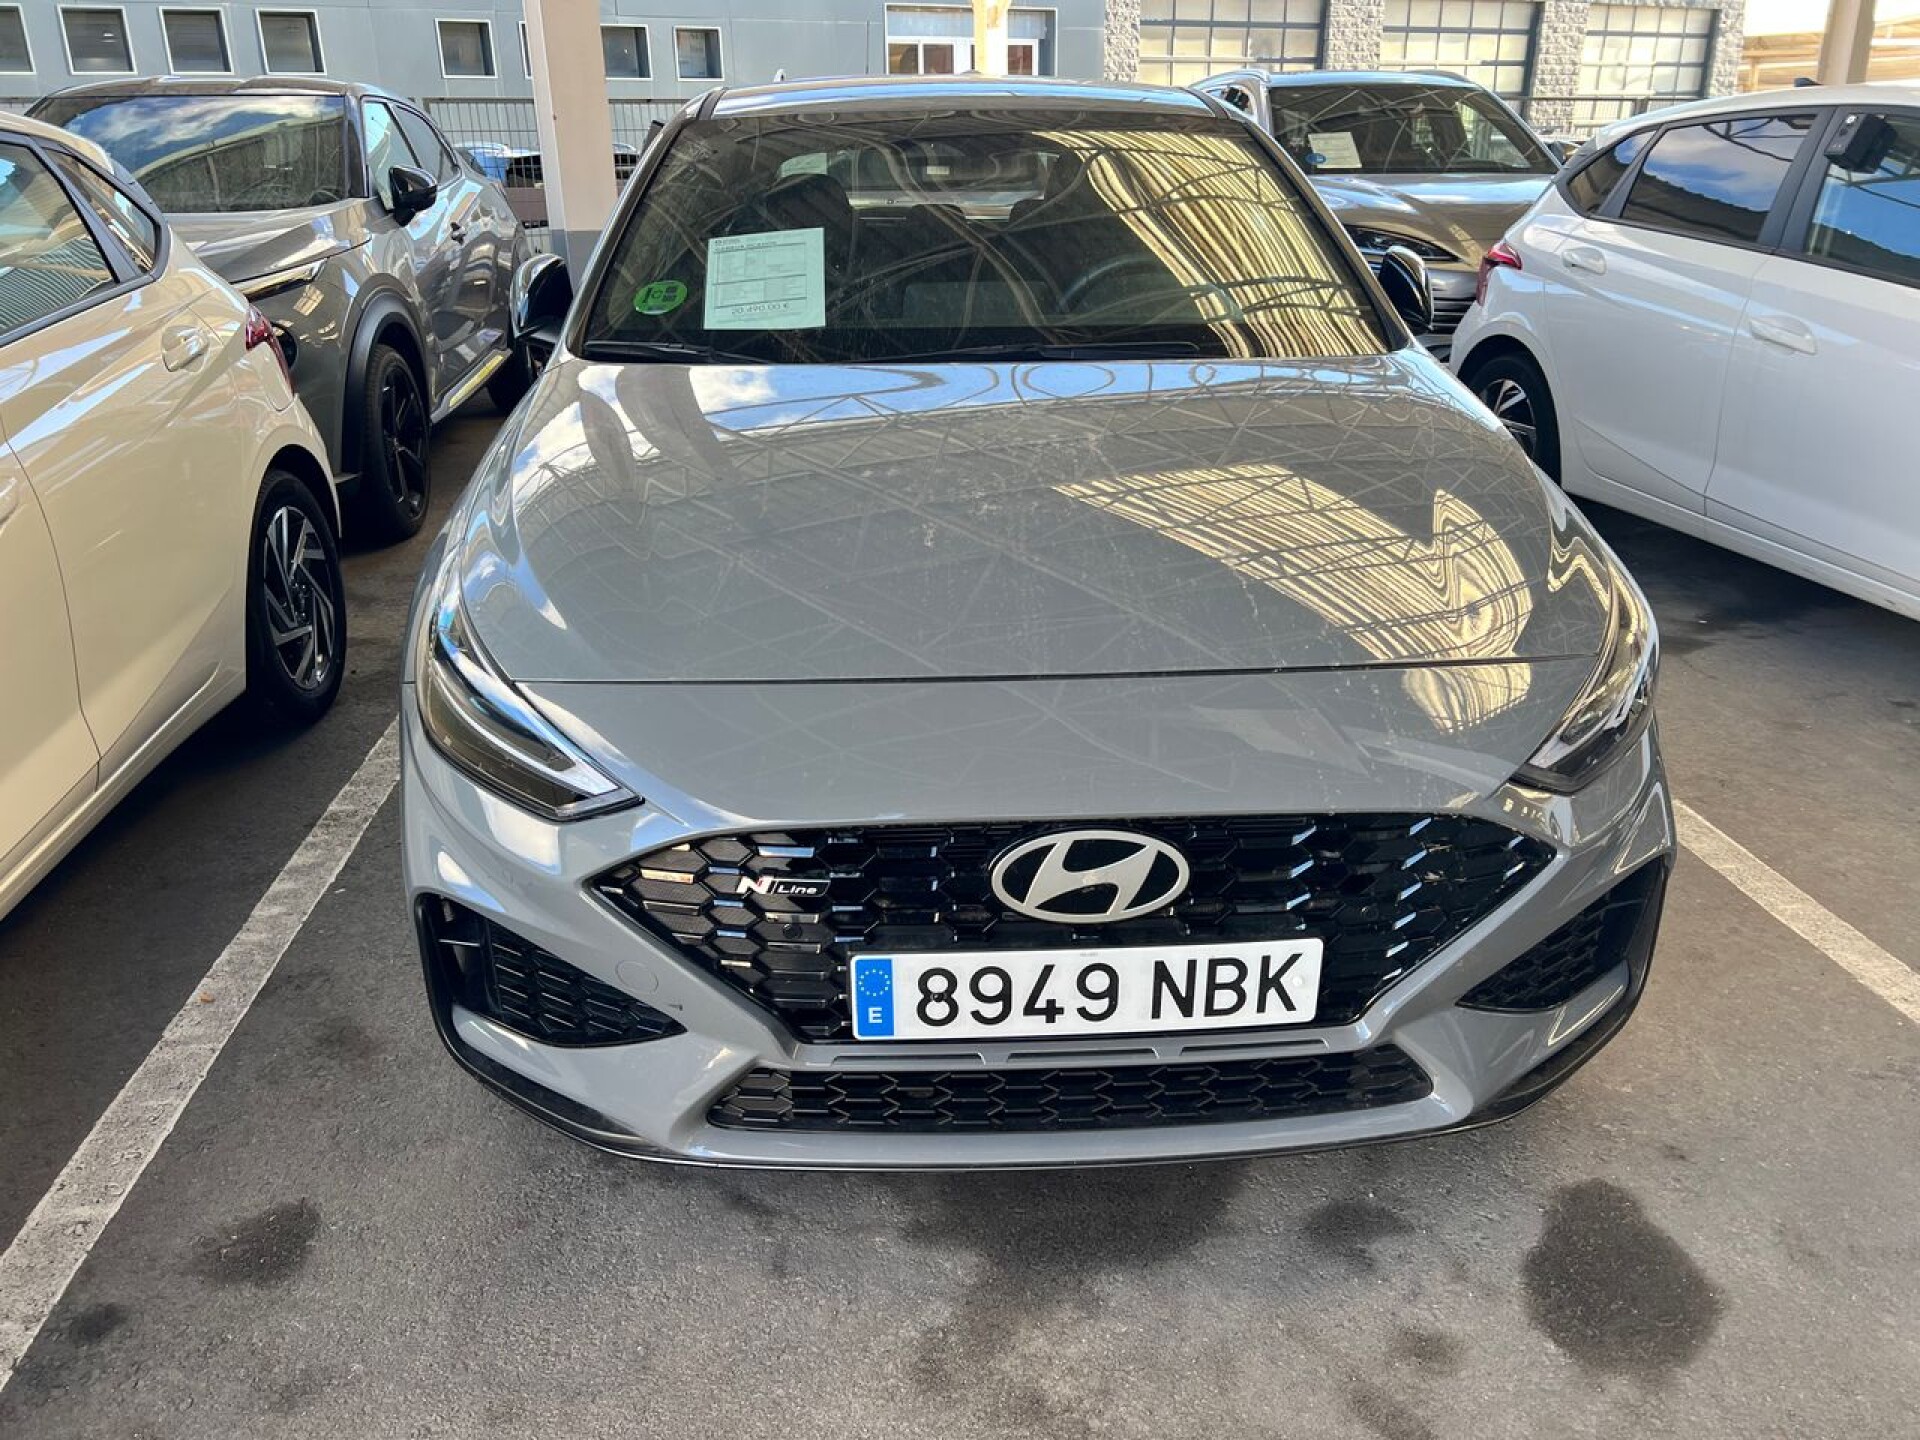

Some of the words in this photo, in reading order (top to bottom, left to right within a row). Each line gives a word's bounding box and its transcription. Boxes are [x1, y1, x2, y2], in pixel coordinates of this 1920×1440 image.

[736, 875, 775, 895] N
[777, 884, 818, 895] Line
[916, 962, 1121, 1027] 8949
[1150, 953, 1304, 1019] NBK
[868, 1006, 882, 1024] E
